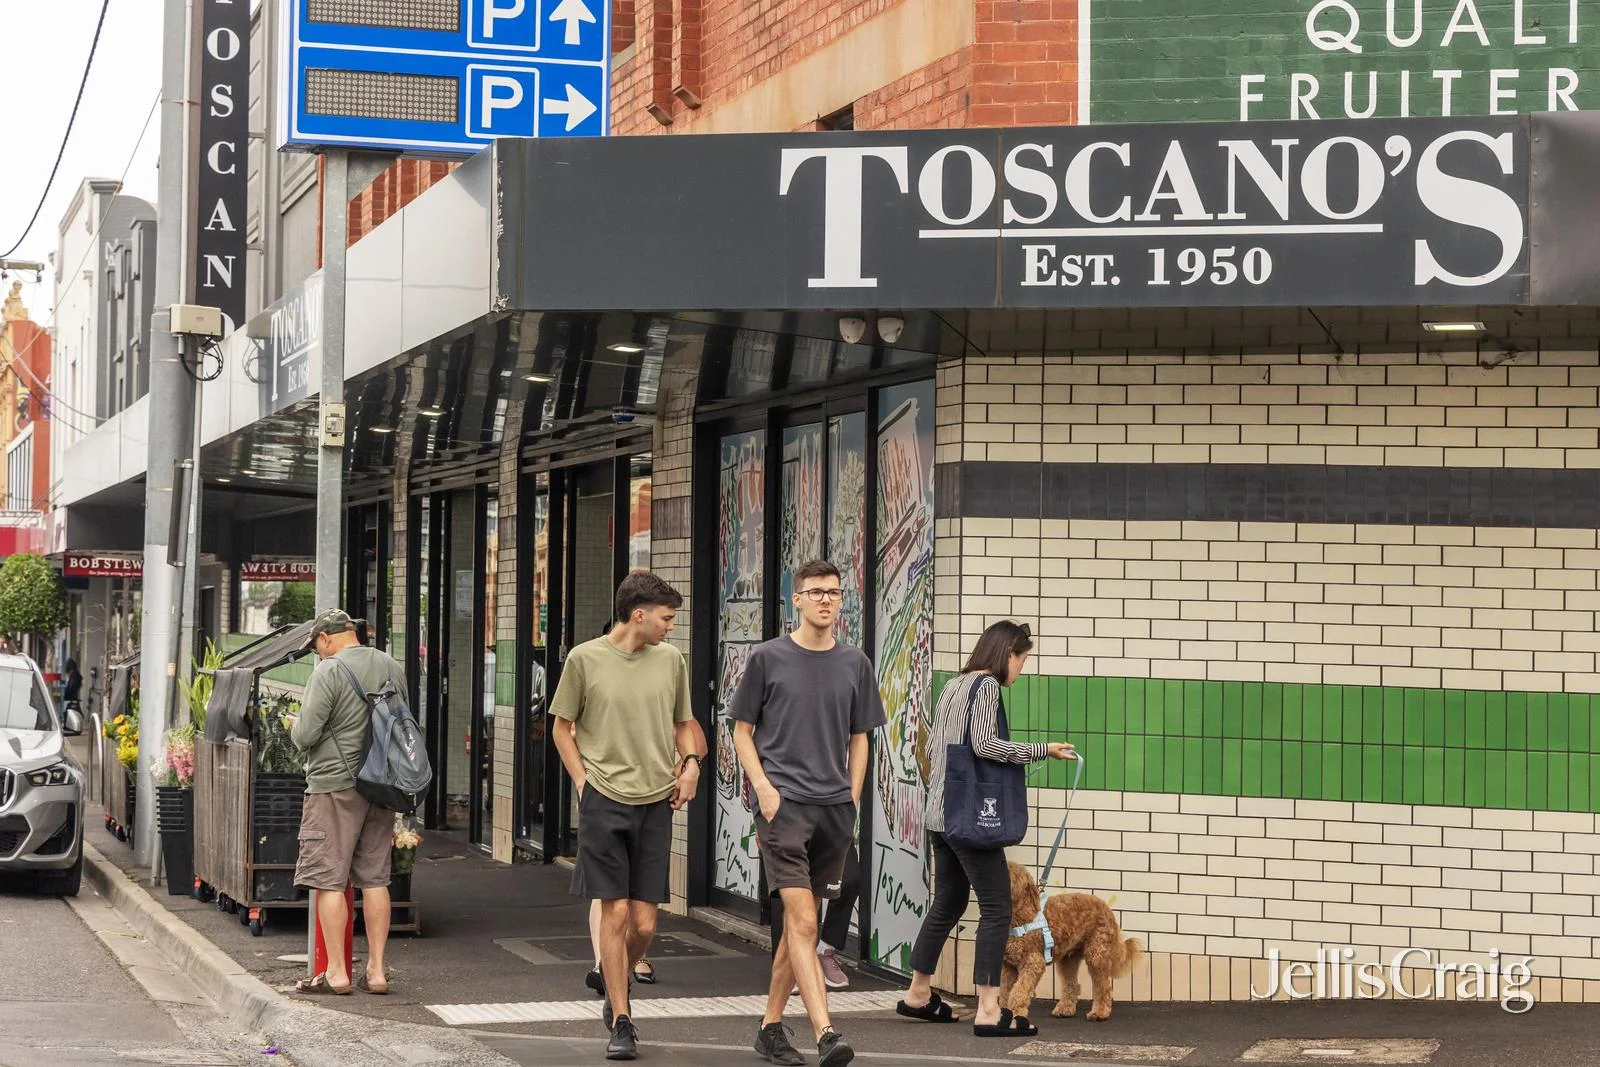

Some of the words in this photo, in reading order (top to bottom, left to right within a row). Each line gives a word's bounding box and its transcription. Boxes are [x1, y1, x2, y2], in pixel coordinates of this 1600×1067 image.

[483, 0, 525, 38] P
[1306, 0, 1578, 53] QUALI
[481, 75, 524, 128] P
[1240, 67, 1580, 121] FRUITER
[203, 0, 240, 338] OSCAN
[779, 129, 1525, 288] TOSCANO'S
[1147, 245, 1273, 286] 1950
[69, 558, 100, 569] BOB
